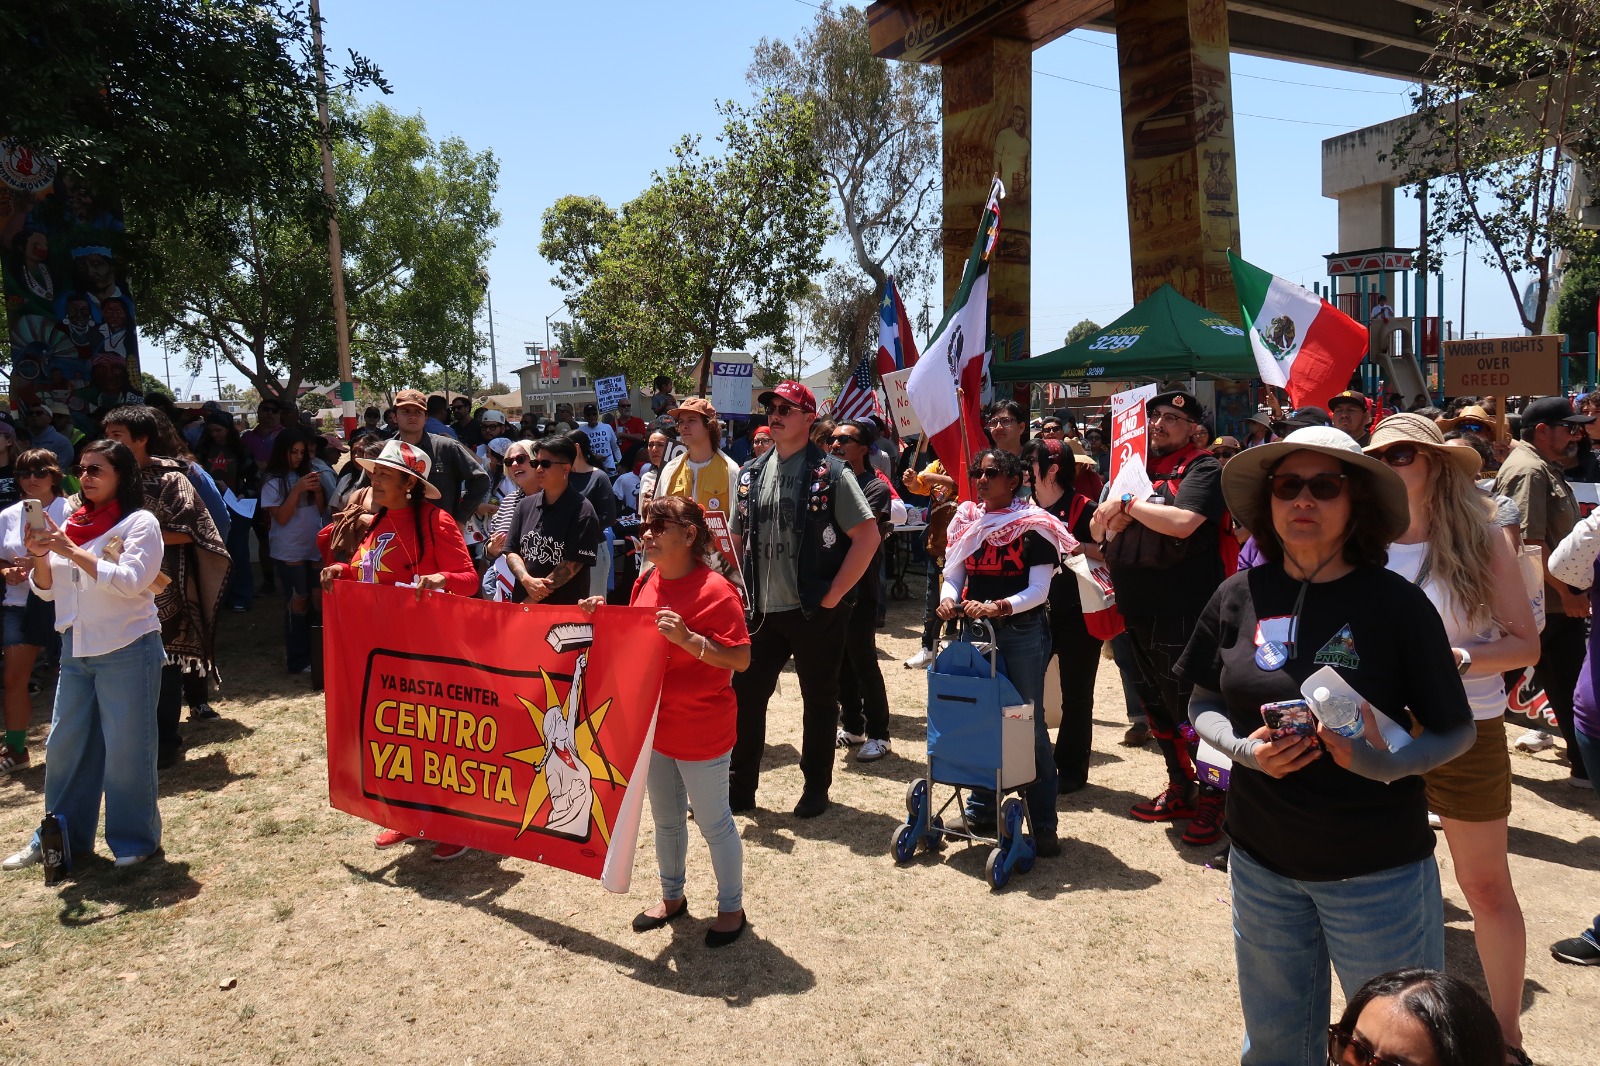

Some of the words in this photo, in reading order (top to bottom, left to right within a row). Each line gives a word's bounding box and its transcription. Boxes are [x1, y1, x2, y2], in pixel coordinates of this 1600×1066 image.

[1089, 335, 1140, 349] 3299
[1448, 343, 1494, 356] WORKER
[1501, 339, 1543, 353] RIGHTS
[716, 363, 751, 376] SEIU
[1477, 357, 1510, 370] OVER
[1087, 367, 1105, 375] 3299
[1461, 373, 1510, 386] GREED
[897, 396, 909, 408] No
[1113, 397, 1123, 405] No
[901, 416, 910, 427] No
[1121, 416, 1137, 436] AND
[1482, 472, 1496, 480] ONS
[758, 541, 795, 560] EOPL
[1314, 654, 1360, 668] PNWSU
[380, 673, 397, 691] YA
[400, 677, 444, 698] BASTA
[446, 683, 499, 707] CENTER
[374, 700, 498, 752] CENTRO
[369, 740, 413, 783] YA
[423, 750, 519, 807] BASTA
